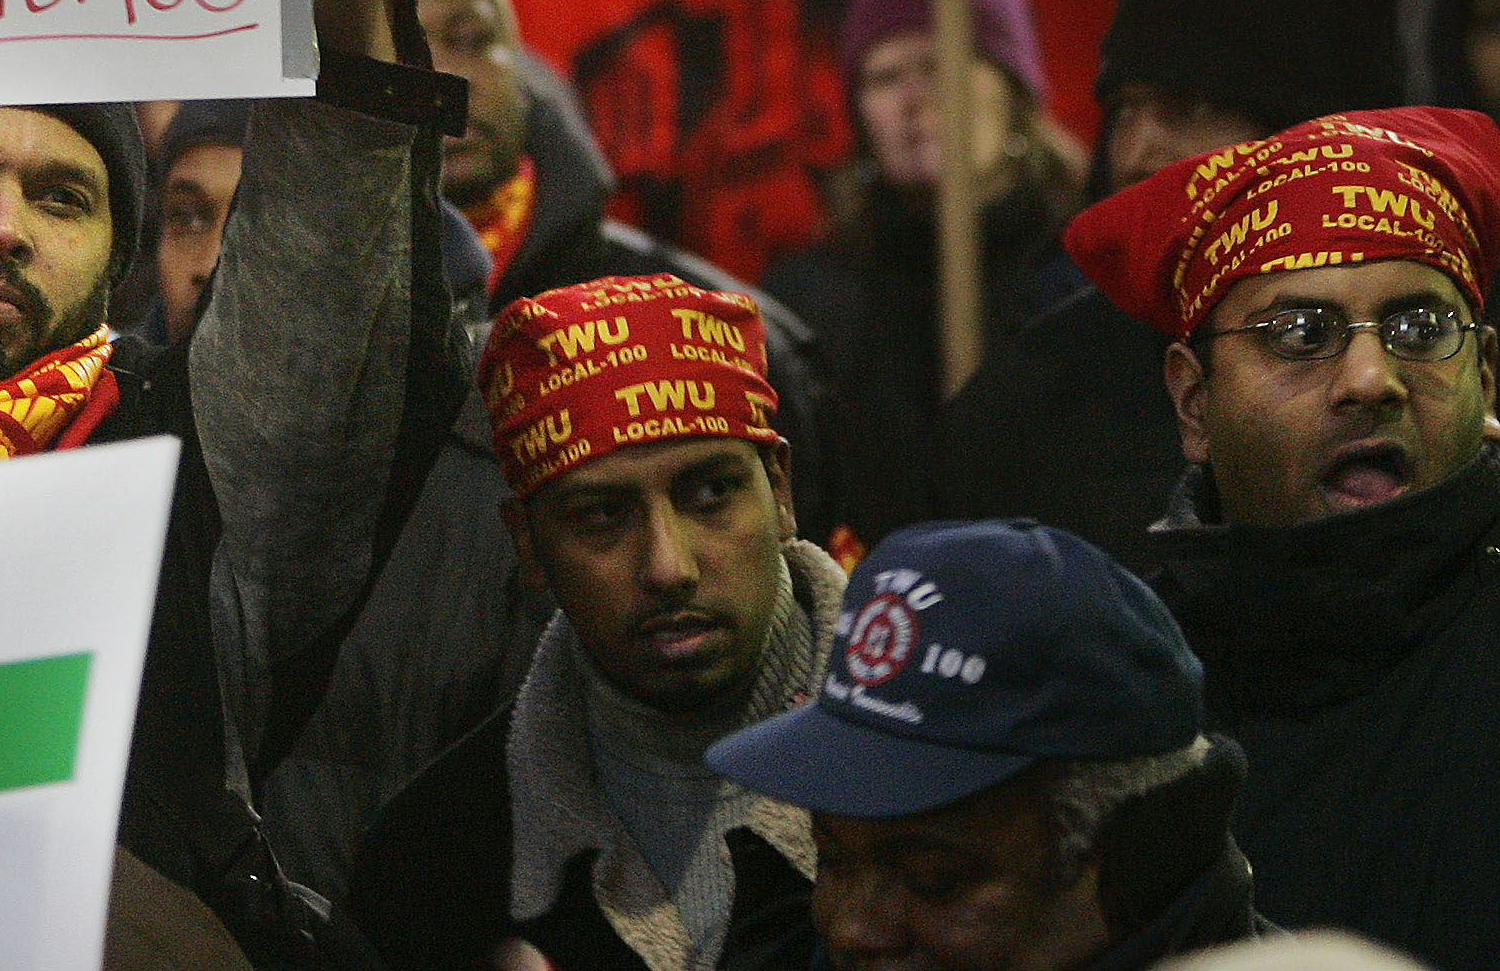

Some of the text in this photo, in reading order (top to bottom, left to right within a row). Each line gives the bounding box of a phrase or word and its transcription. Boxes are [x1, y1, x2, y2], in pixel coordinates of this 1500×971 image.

[1245, 160, 1371, 201] LOCAL-100
[1331, 184, 1436, 231] TWU
[1203, 199, 1279, 267] TWU
[1321, 212, 1445, 249] LOCAL-100
[536, 316, 631, 368] TWU
[671, 308, 746, 353] TWU
[538, 343, 648, 397] LOCAL-100
[615, 379, 717, 417] TWU
[612, 416, 730, 443] LOCAL-100
[874, 568, 944, 611] TWU
[921, 642, 988, 685] 100
